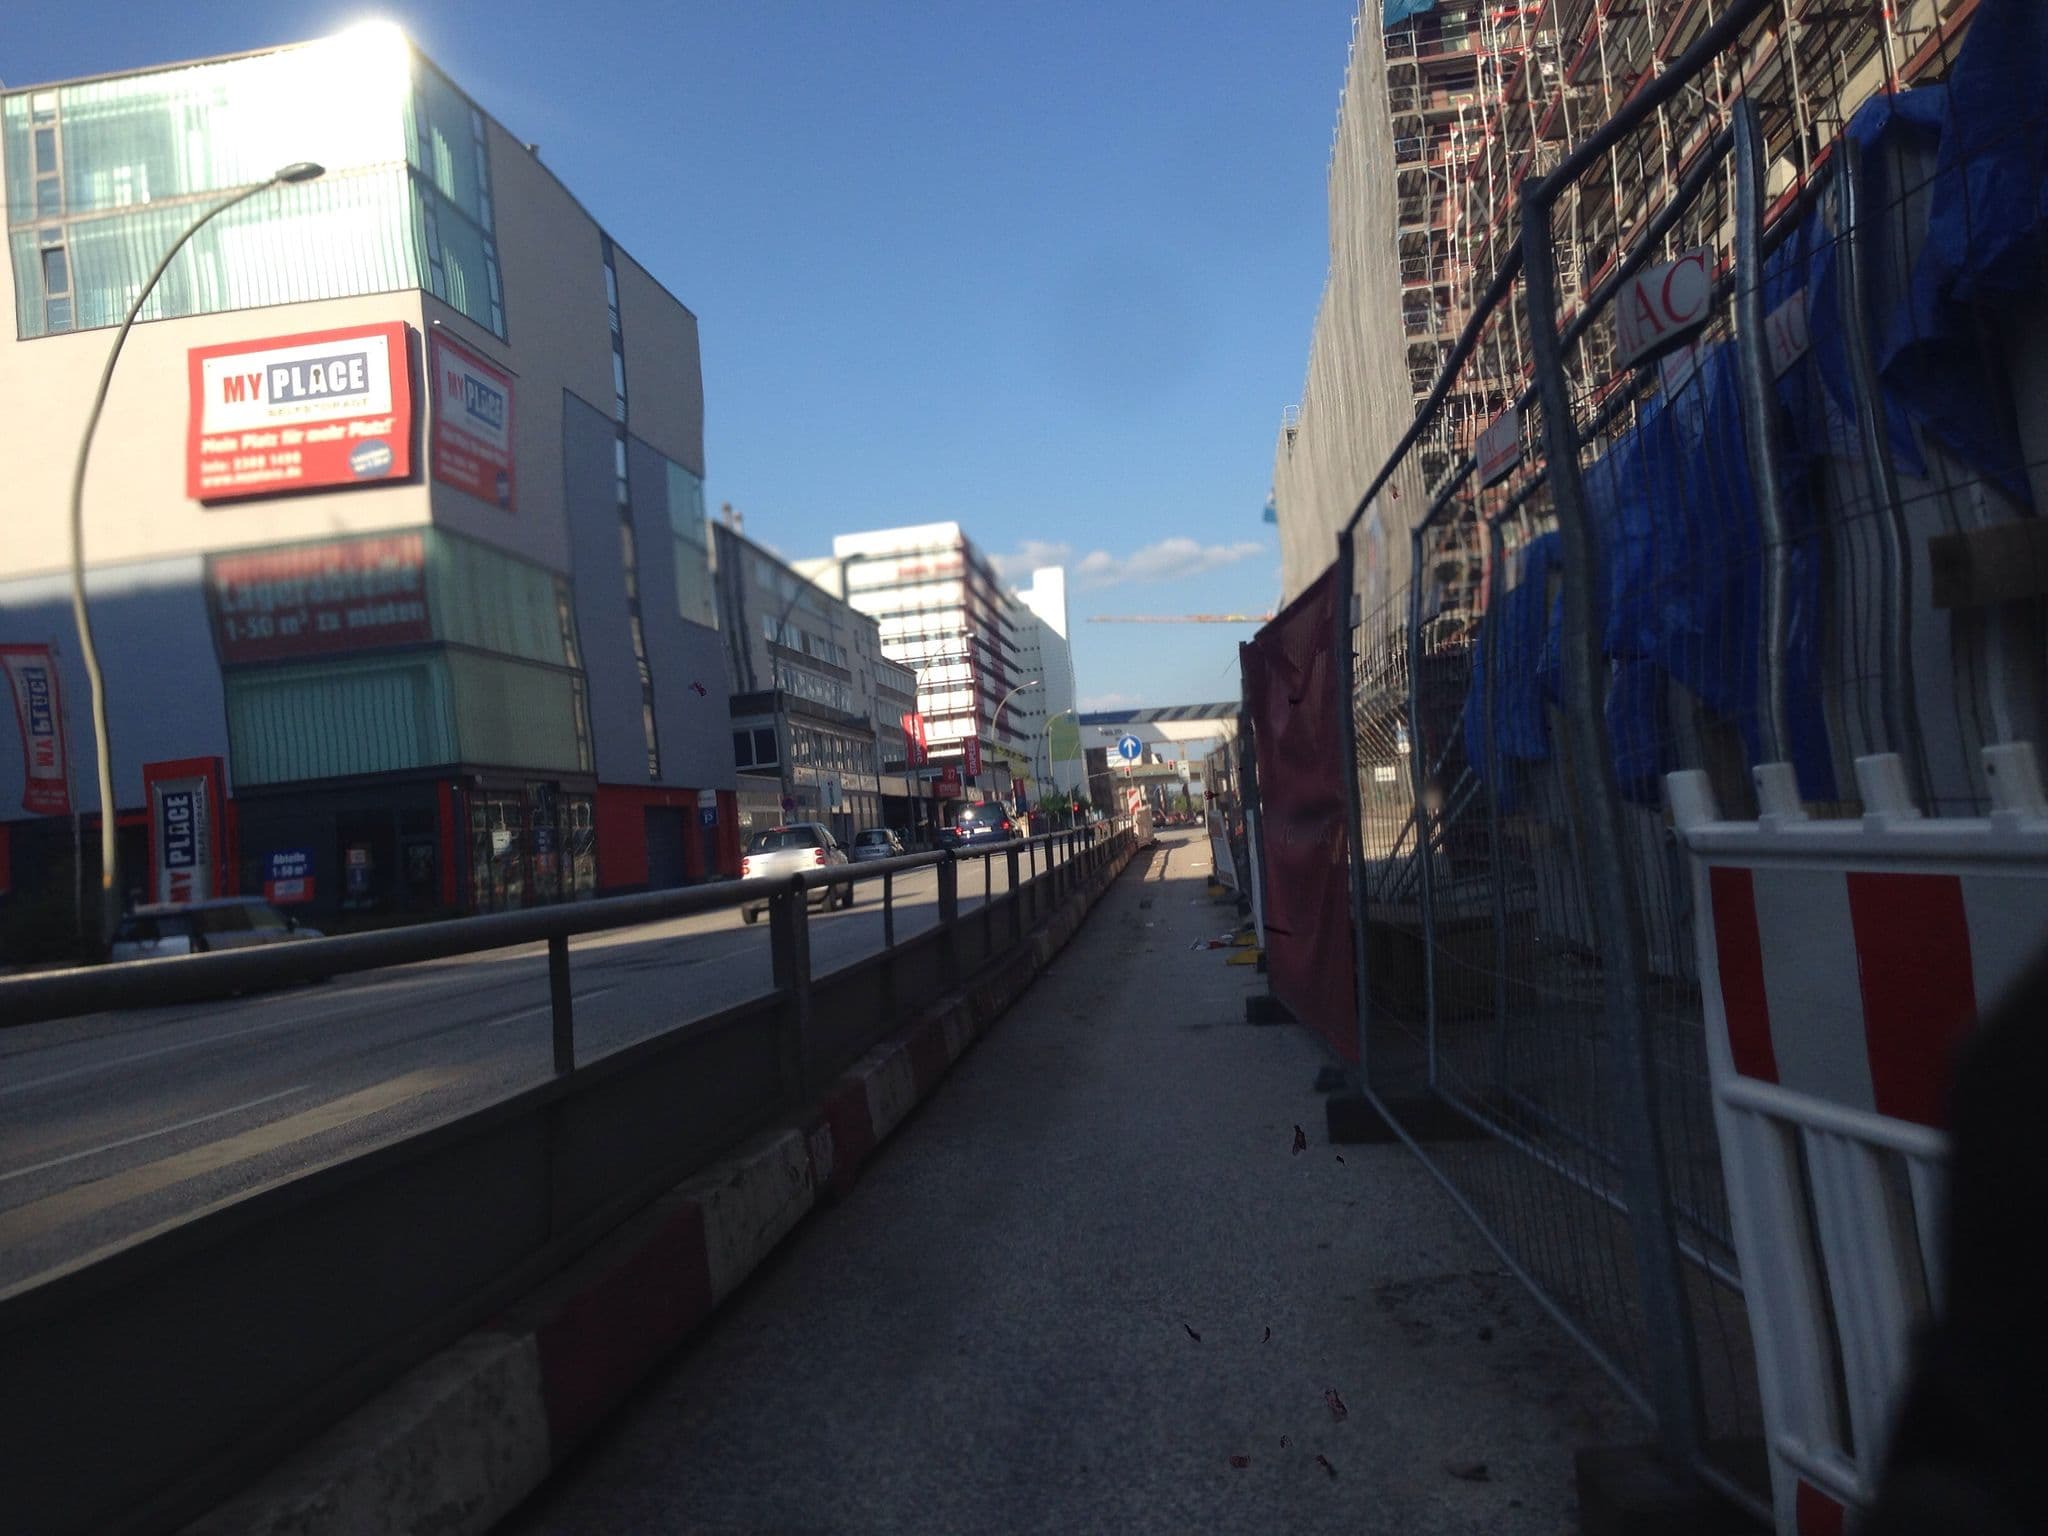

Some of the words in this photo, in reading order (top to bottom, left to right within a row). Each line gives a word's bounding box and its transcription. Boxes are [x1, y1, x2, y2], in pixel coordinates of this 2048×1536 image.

[223, 373, 262, 404] MY
[271, 358, 365, 400] PLACE
[447, 371, 464, 399] MY
[167, 795, 191, 865] PLACE
